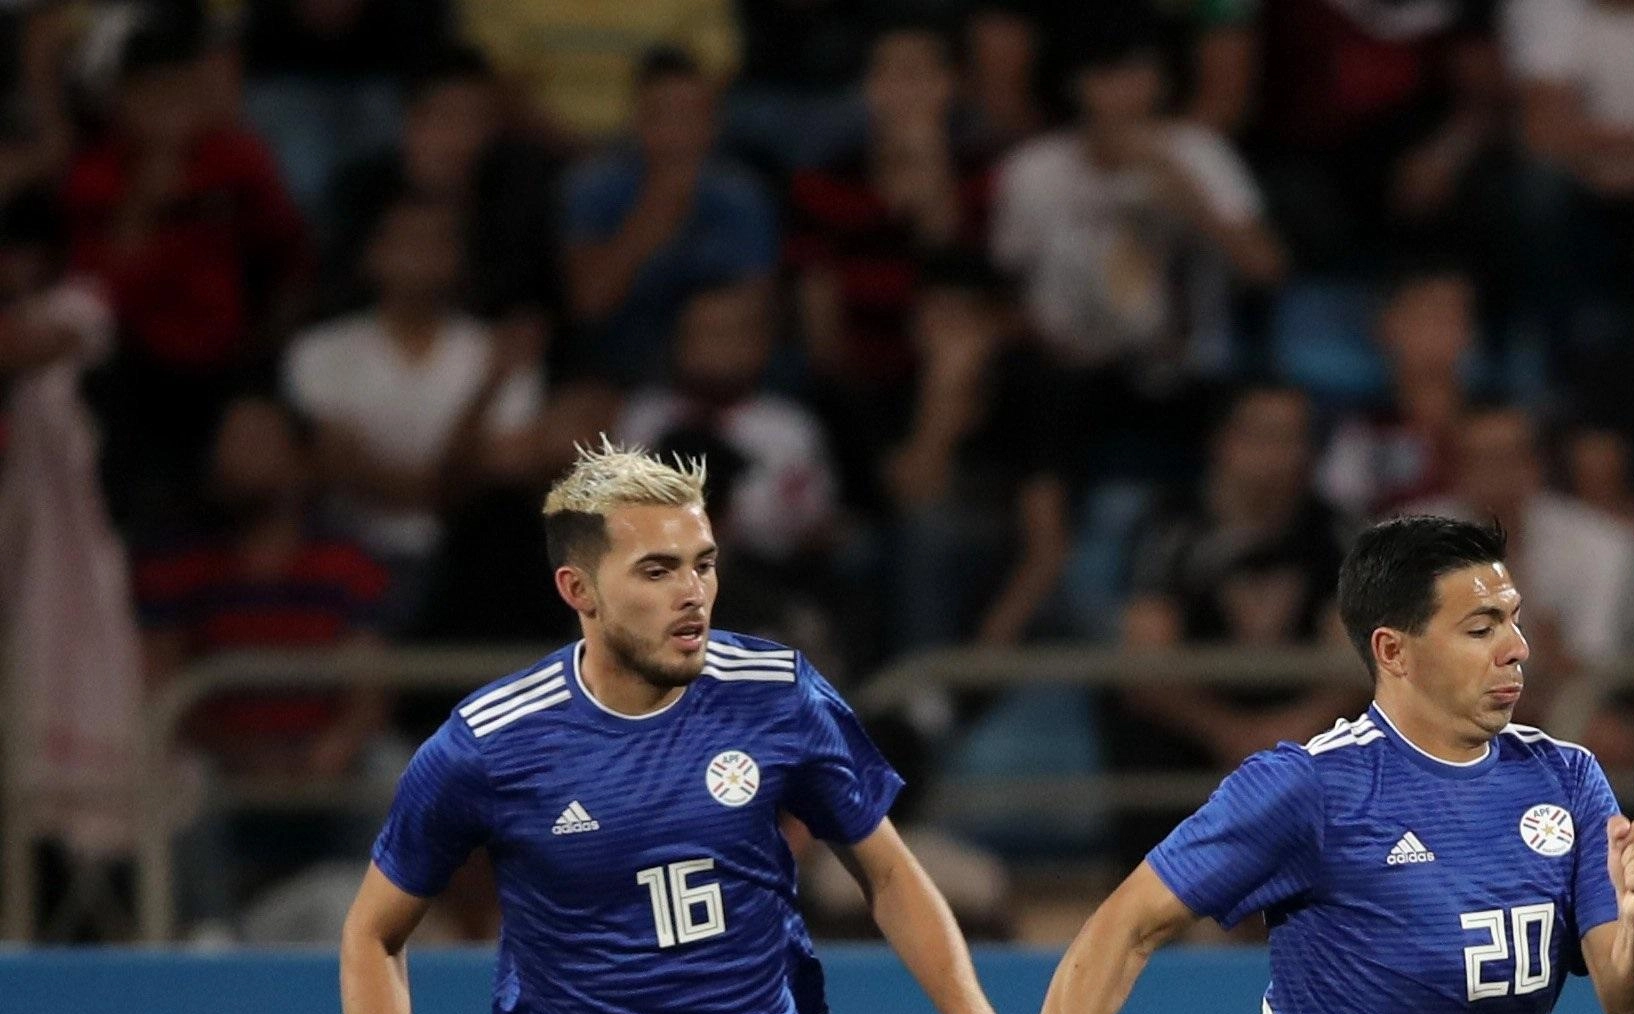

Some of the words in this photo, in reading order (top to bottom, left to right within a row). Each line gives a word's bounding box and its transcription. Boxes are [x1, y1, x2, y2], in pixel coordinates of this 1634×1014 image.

[551, 819, 600, 835] adidas
[1386, 852, 1435, 866] adidas
[636, 857, 726, 948] 16
[1460, 902, 1555, 1002] 20
